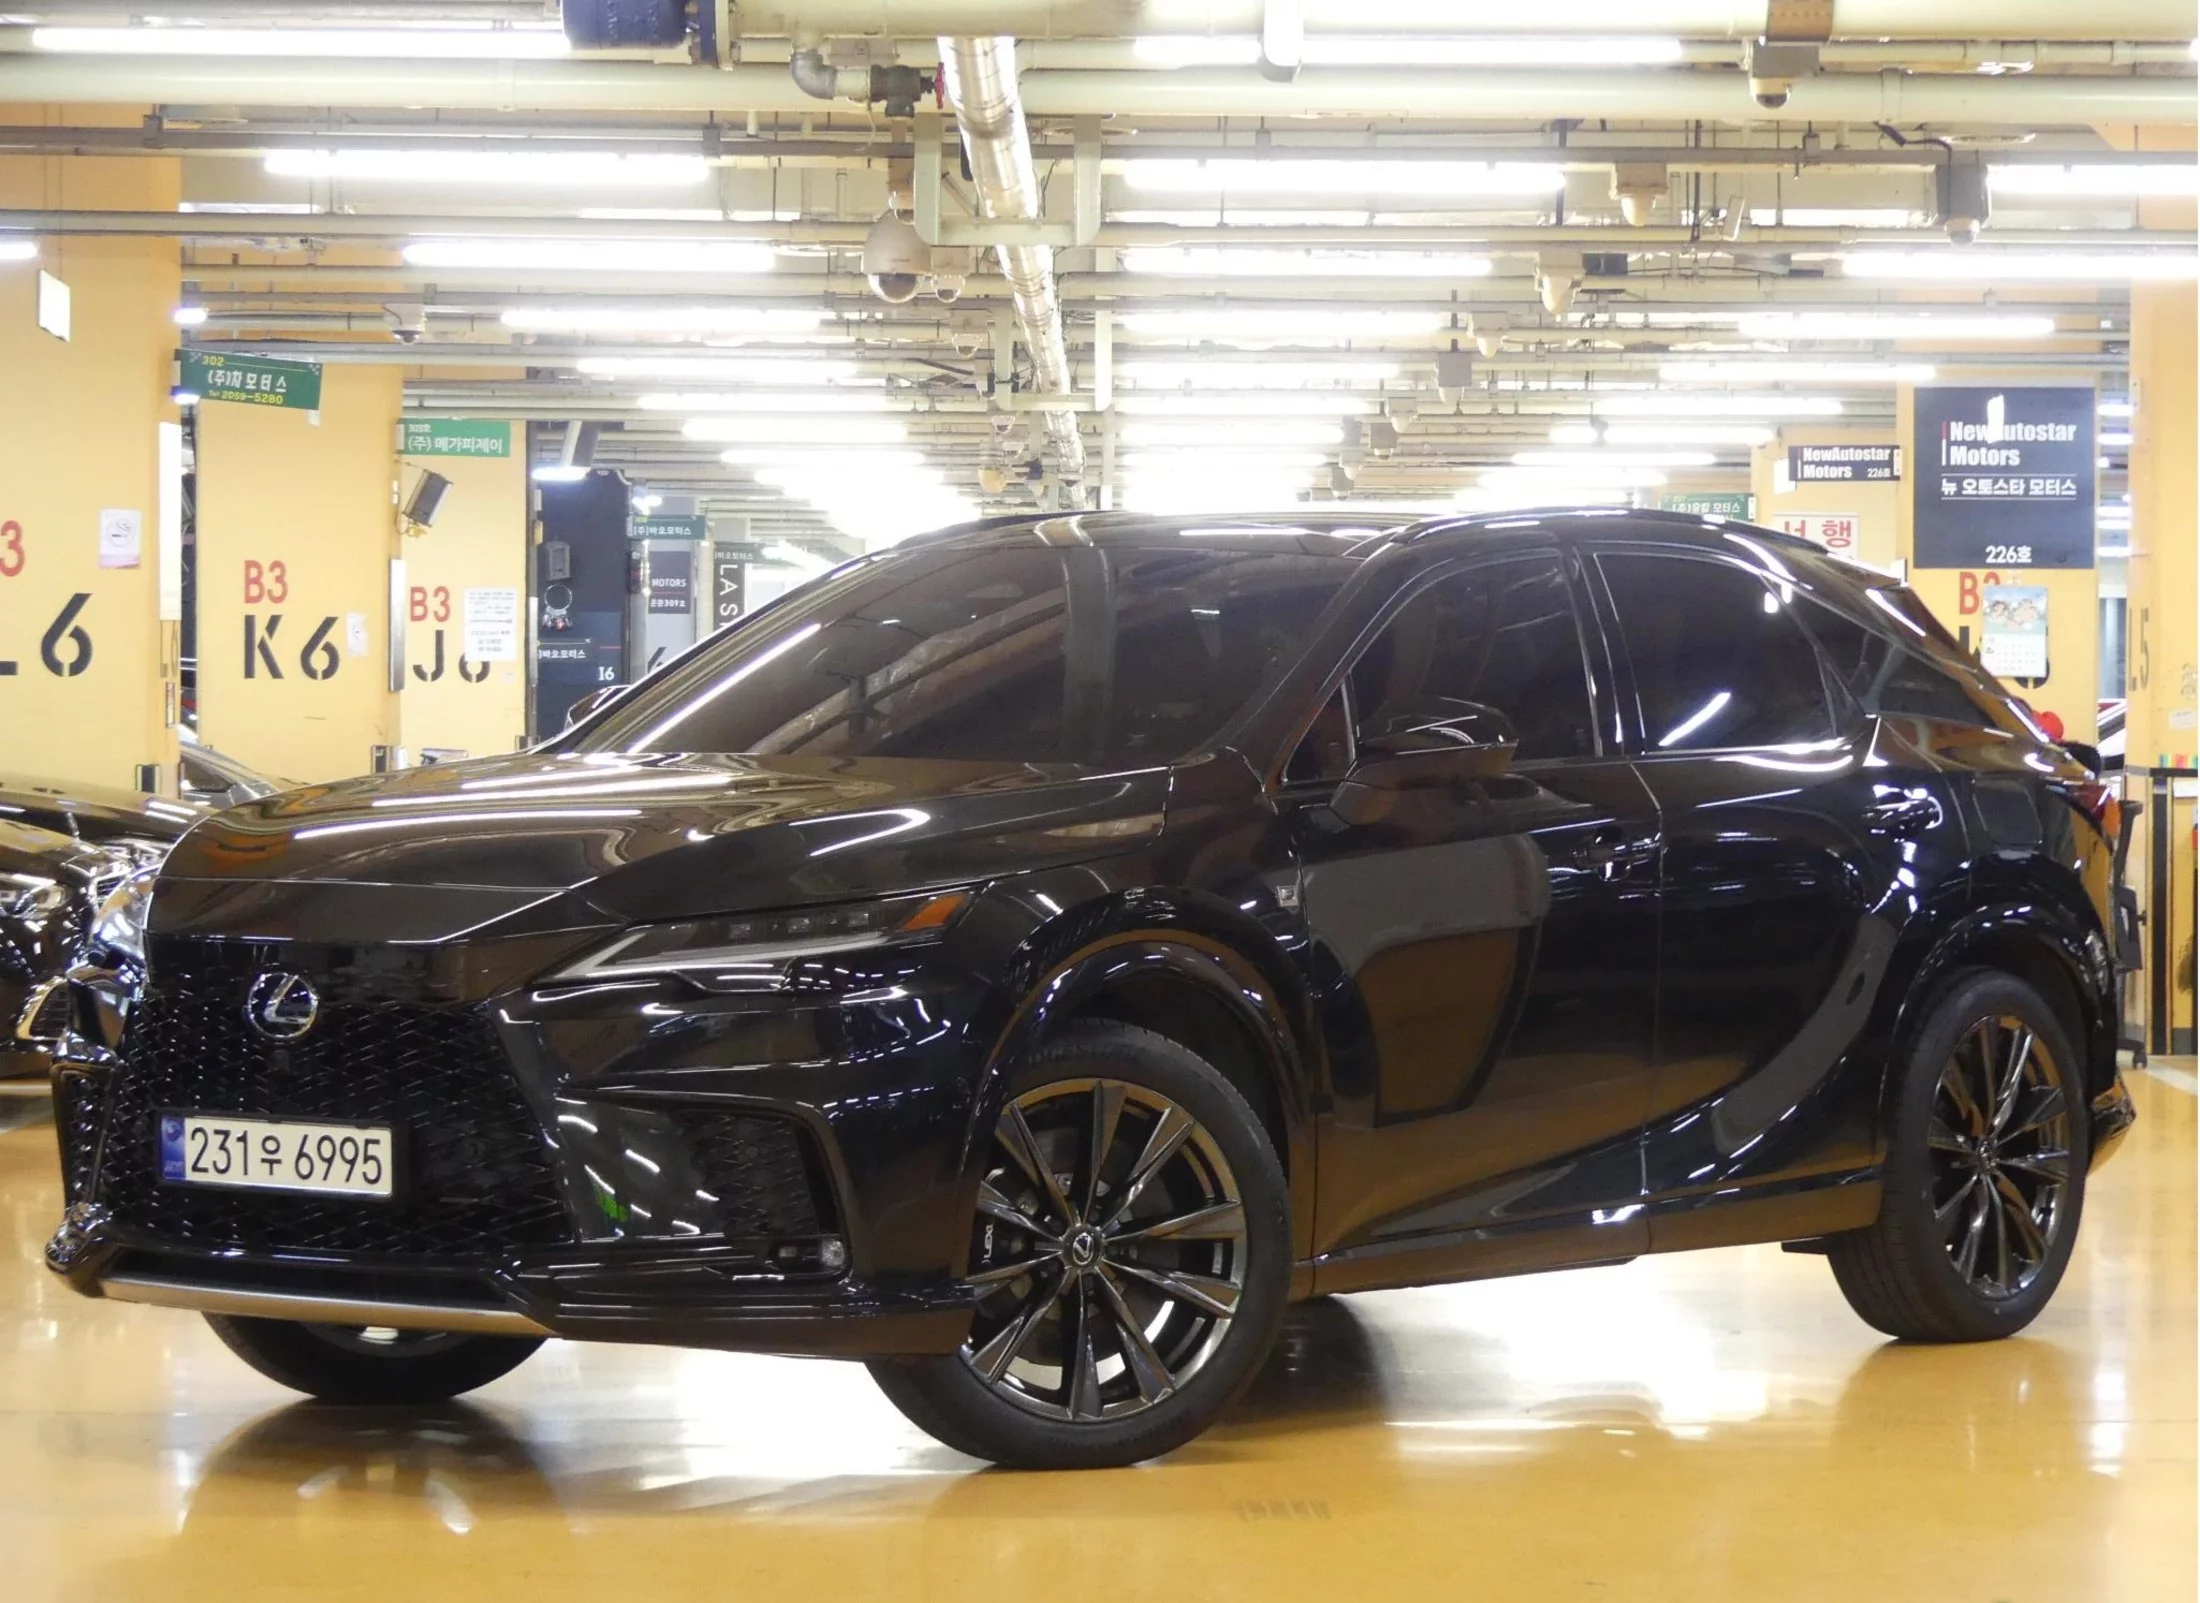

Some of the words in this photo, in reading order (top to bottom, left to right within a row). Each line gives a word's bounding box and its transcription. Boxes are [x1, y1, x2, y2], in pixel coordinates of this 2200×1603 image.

[202, 355, 224, 366] 302
[221, 391, 283, 404] 2059-5280
[1950, 421, 2077, 442] Newutostar
[1803, 446, 1891, 461] NewAutostar
[1950, 445, 2021, 466] Motors
[1803, 464, 1853, 478] Motors
[1941, 478, 1957, 496] 뉴
[1961, 478, 2025, 496] 오토스타
[2029, 478, 2077, 496] 모터스
[1985, 545, 2032, 563] 226호
[244, 560, 288, 604] B3
[652, 578, 687, 588] MOTORS
[410, 586, 450, 622] B3
